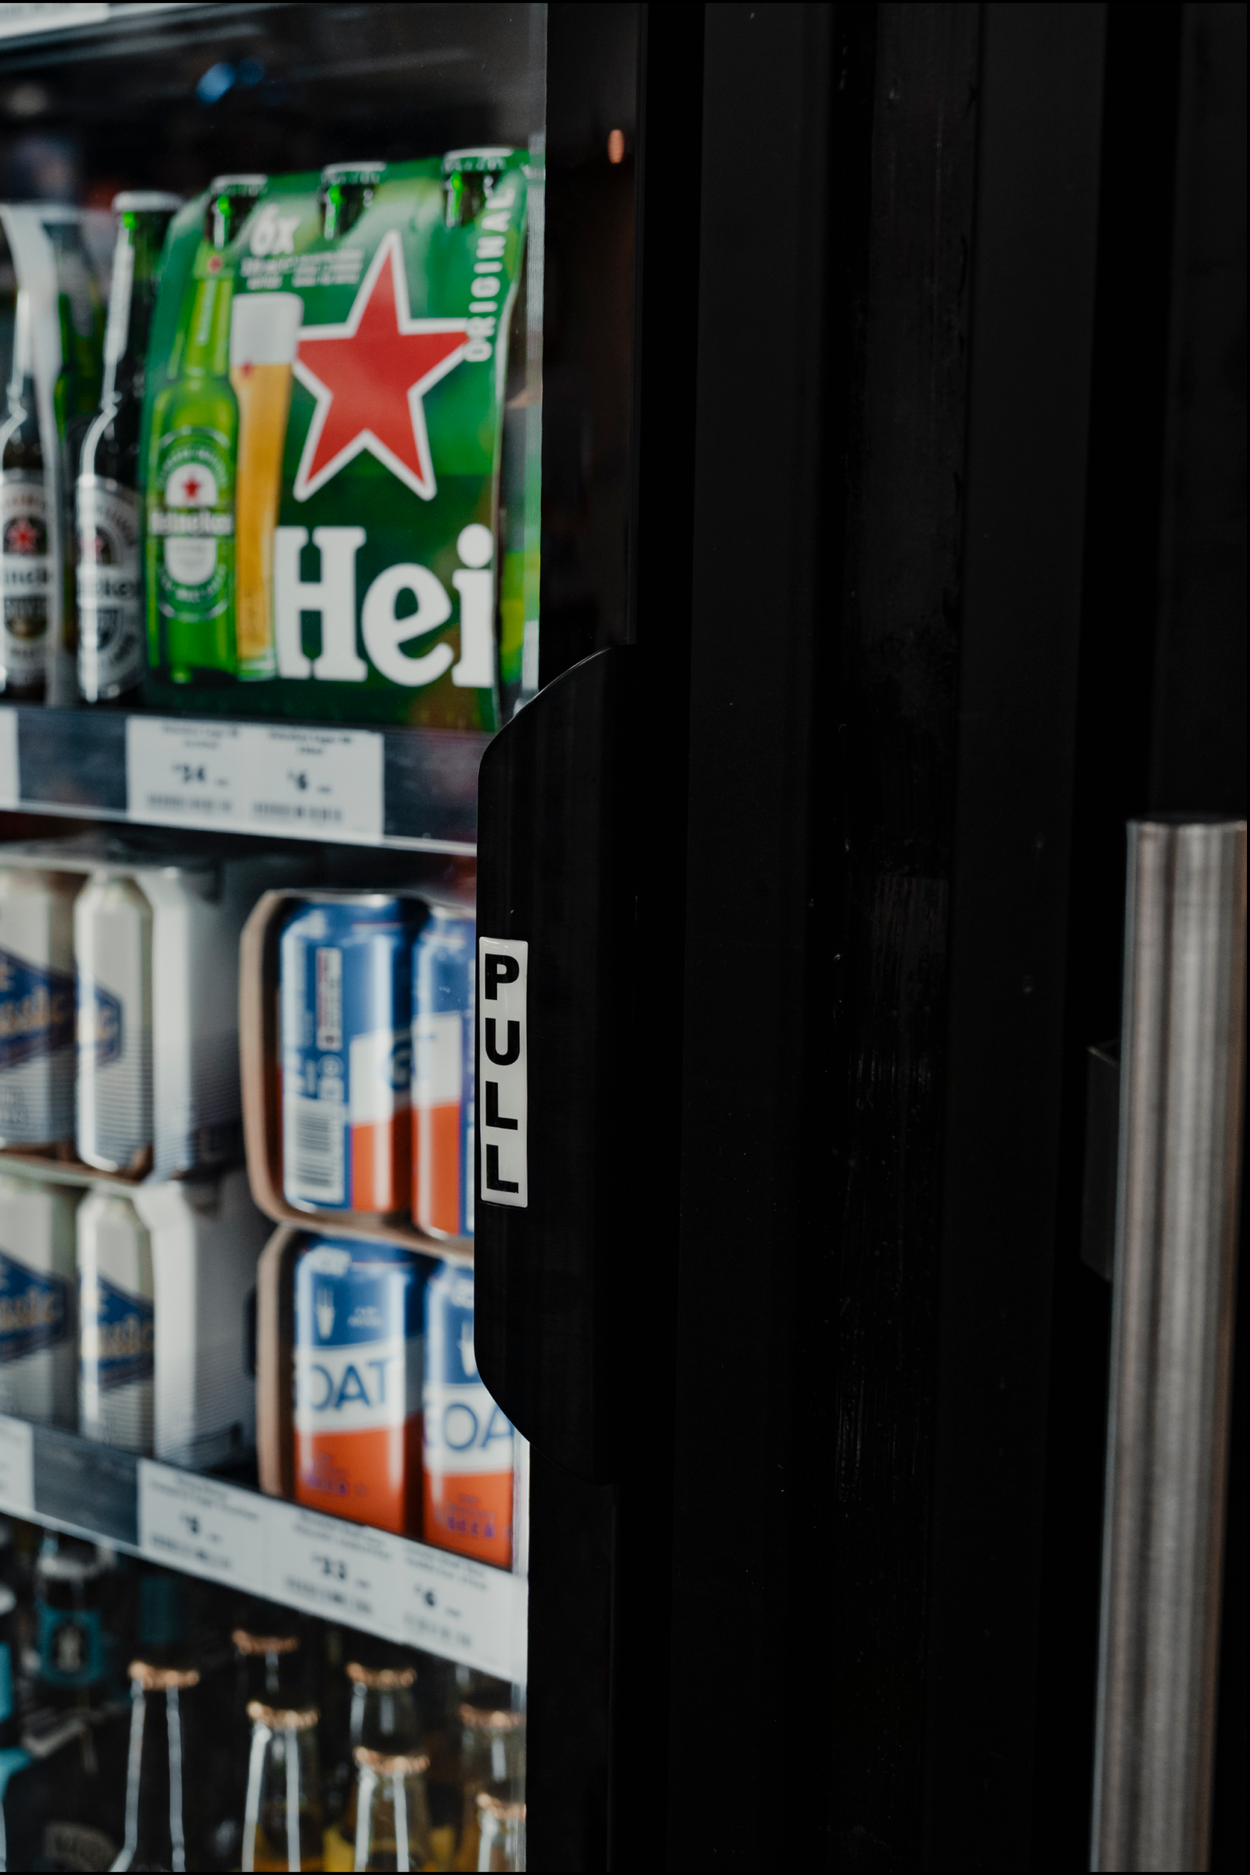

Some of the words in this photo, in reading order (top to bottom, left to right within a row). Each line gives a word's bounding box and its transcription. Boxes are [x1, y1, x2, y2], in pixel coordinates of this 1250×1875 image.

[464, 188, 516, 362] ORIGINAL
[274, 523, 495, 688] Hei
[484, 952, 521, 1195] PULL
[300, 1357, 396, 1412] OAT
